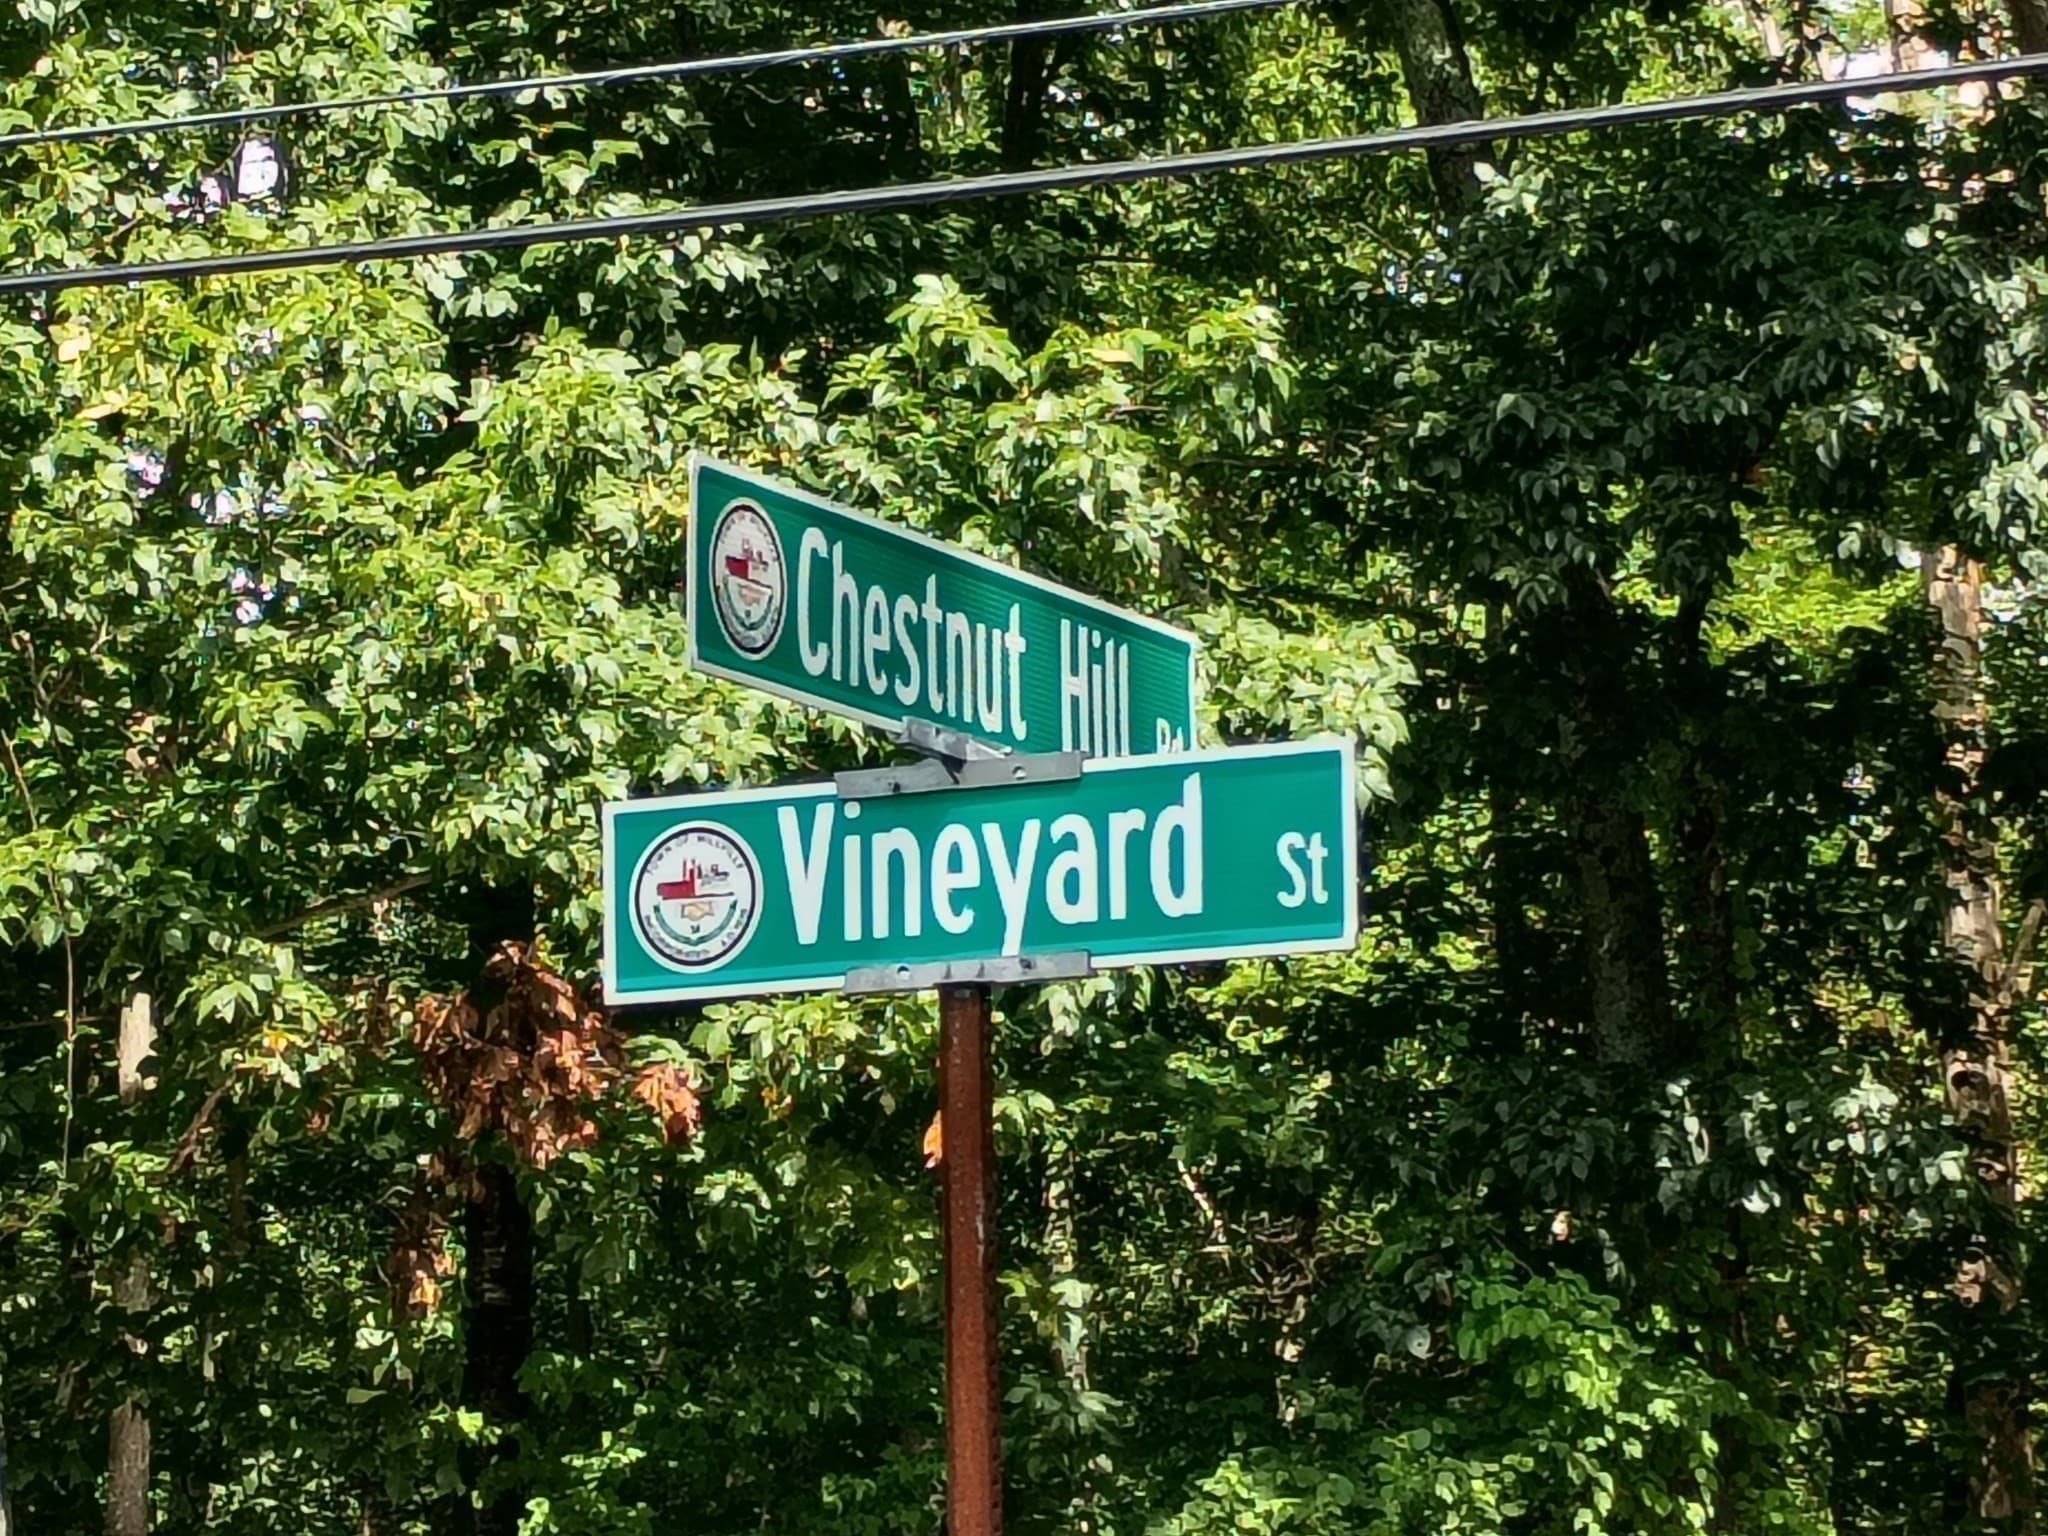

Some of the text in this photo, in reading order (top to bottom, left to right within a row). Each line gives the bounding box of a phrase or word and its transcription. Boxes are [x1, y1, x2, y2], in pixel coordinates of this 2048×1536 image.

[798, 527, 1027, 741] Chestnut
[1060, 618, 1130, 757] Hill
[777, 772, 1329, 956] Vineyard St
